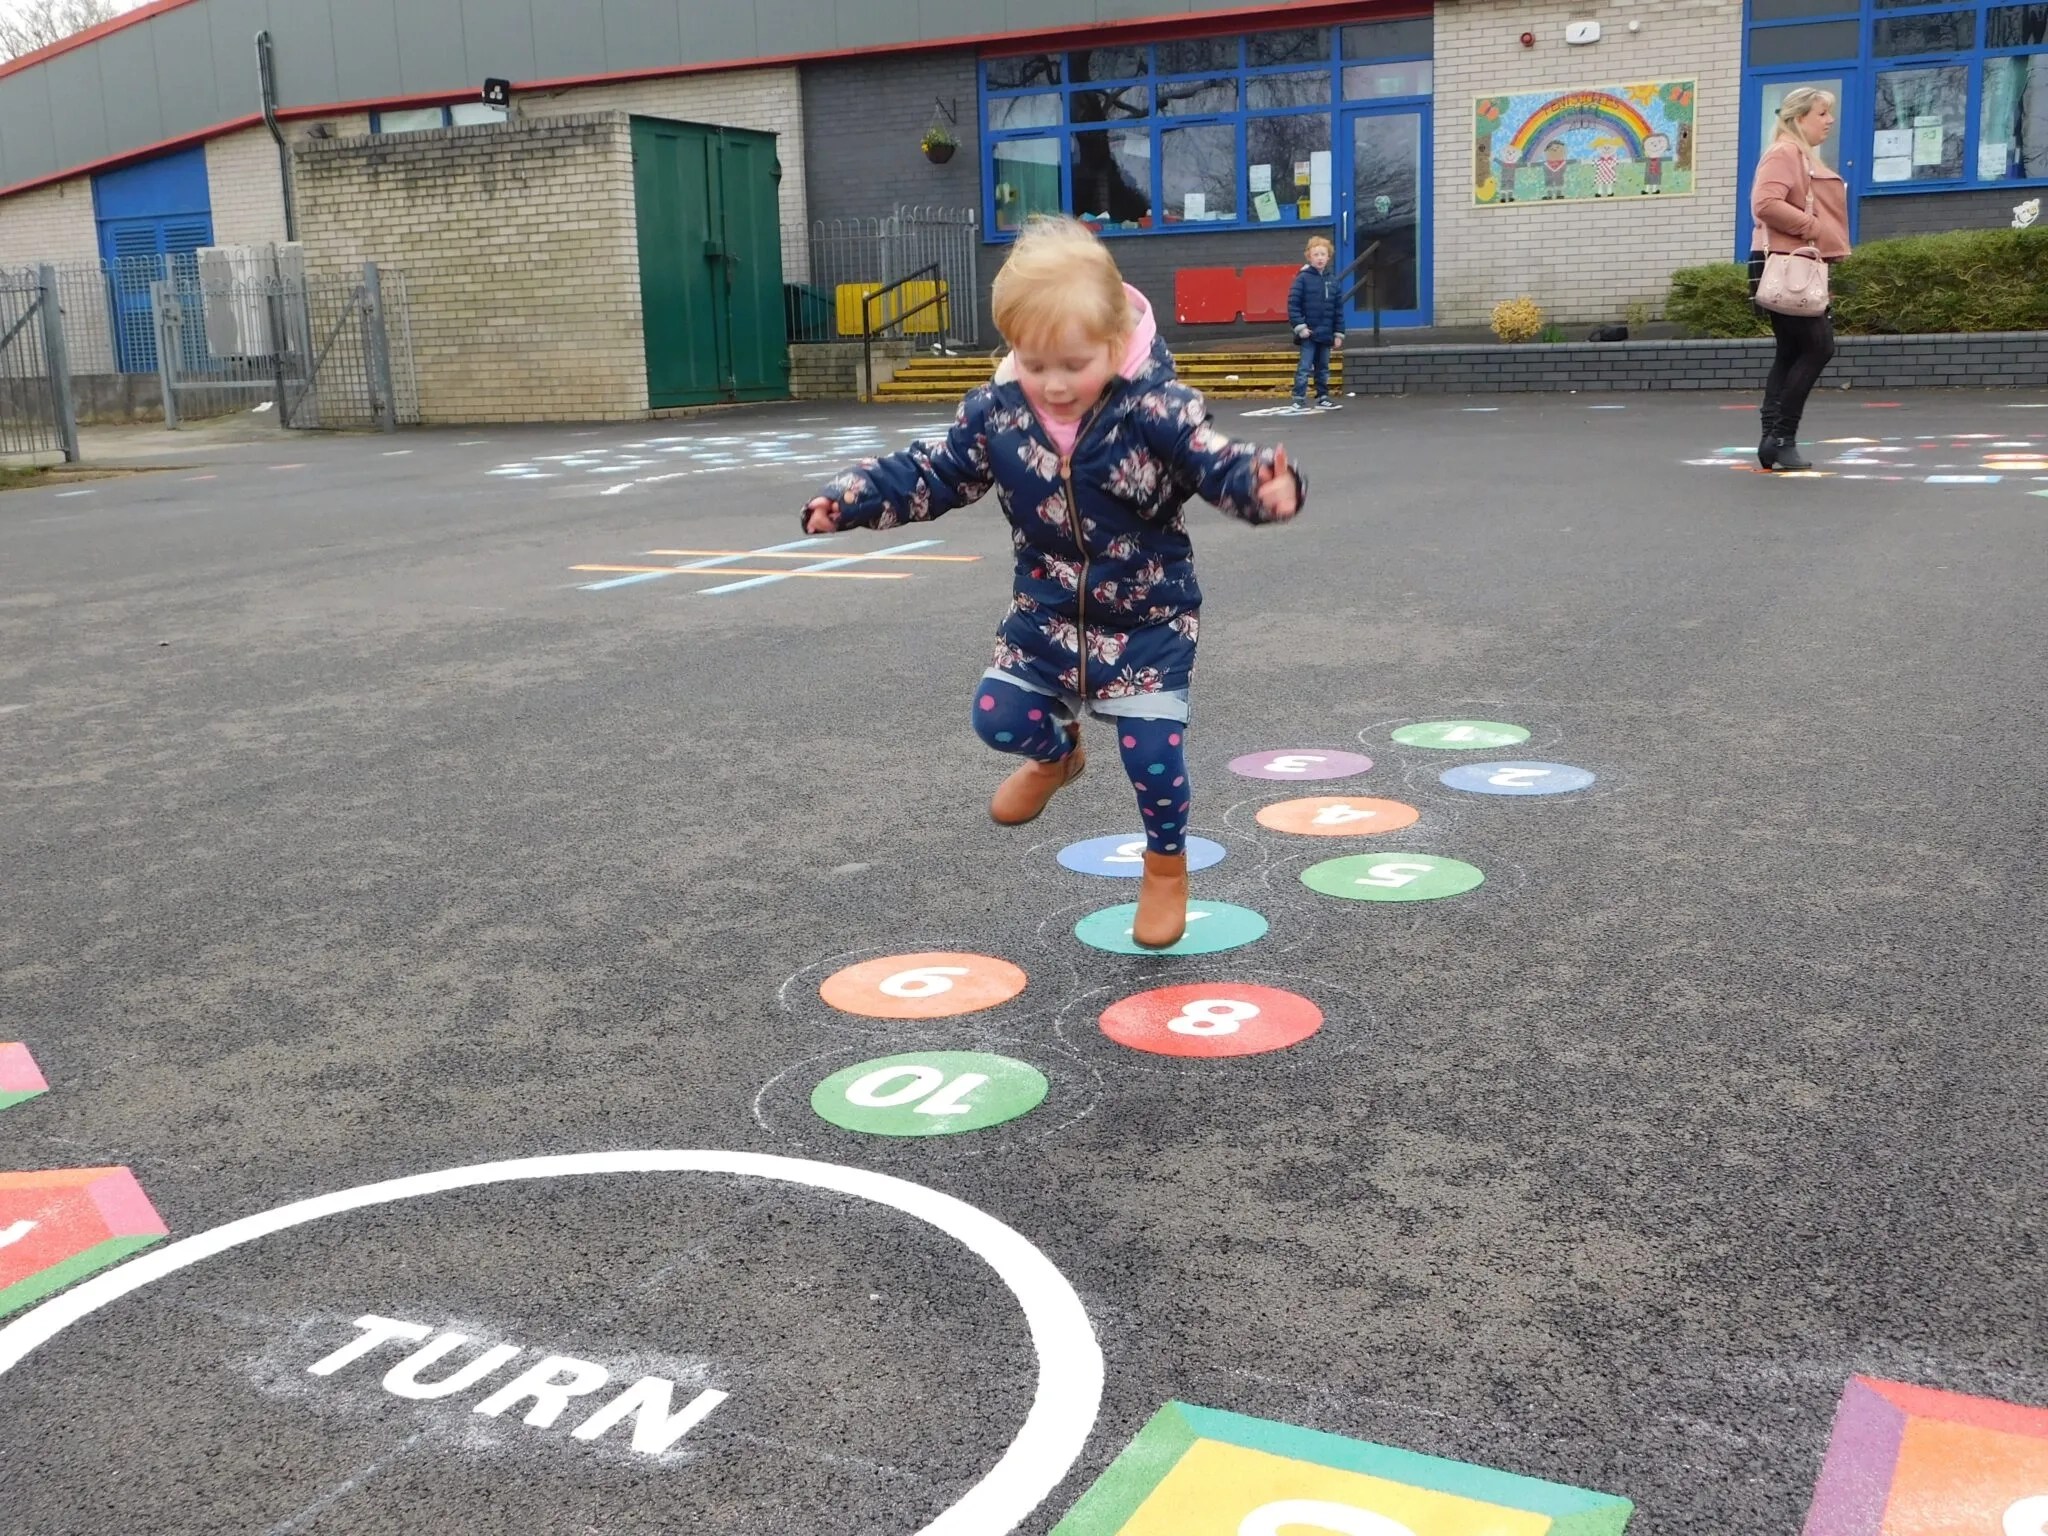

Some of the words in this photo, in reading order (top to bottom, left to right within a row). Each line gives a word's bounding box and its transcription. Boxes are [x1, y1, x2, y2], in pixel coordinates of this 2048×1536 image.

[1263, 755, 1327, 773] 3
[1488, 767, 1551, 787] 2
[1311, 804, 1377, 826] 4
[1355, 862, 1434, 888] 5
[1167, 999, 1260, 1037] 8
[845, 1065, 989, 1115] 10
[307, 1314, 729, 1454] TURN
